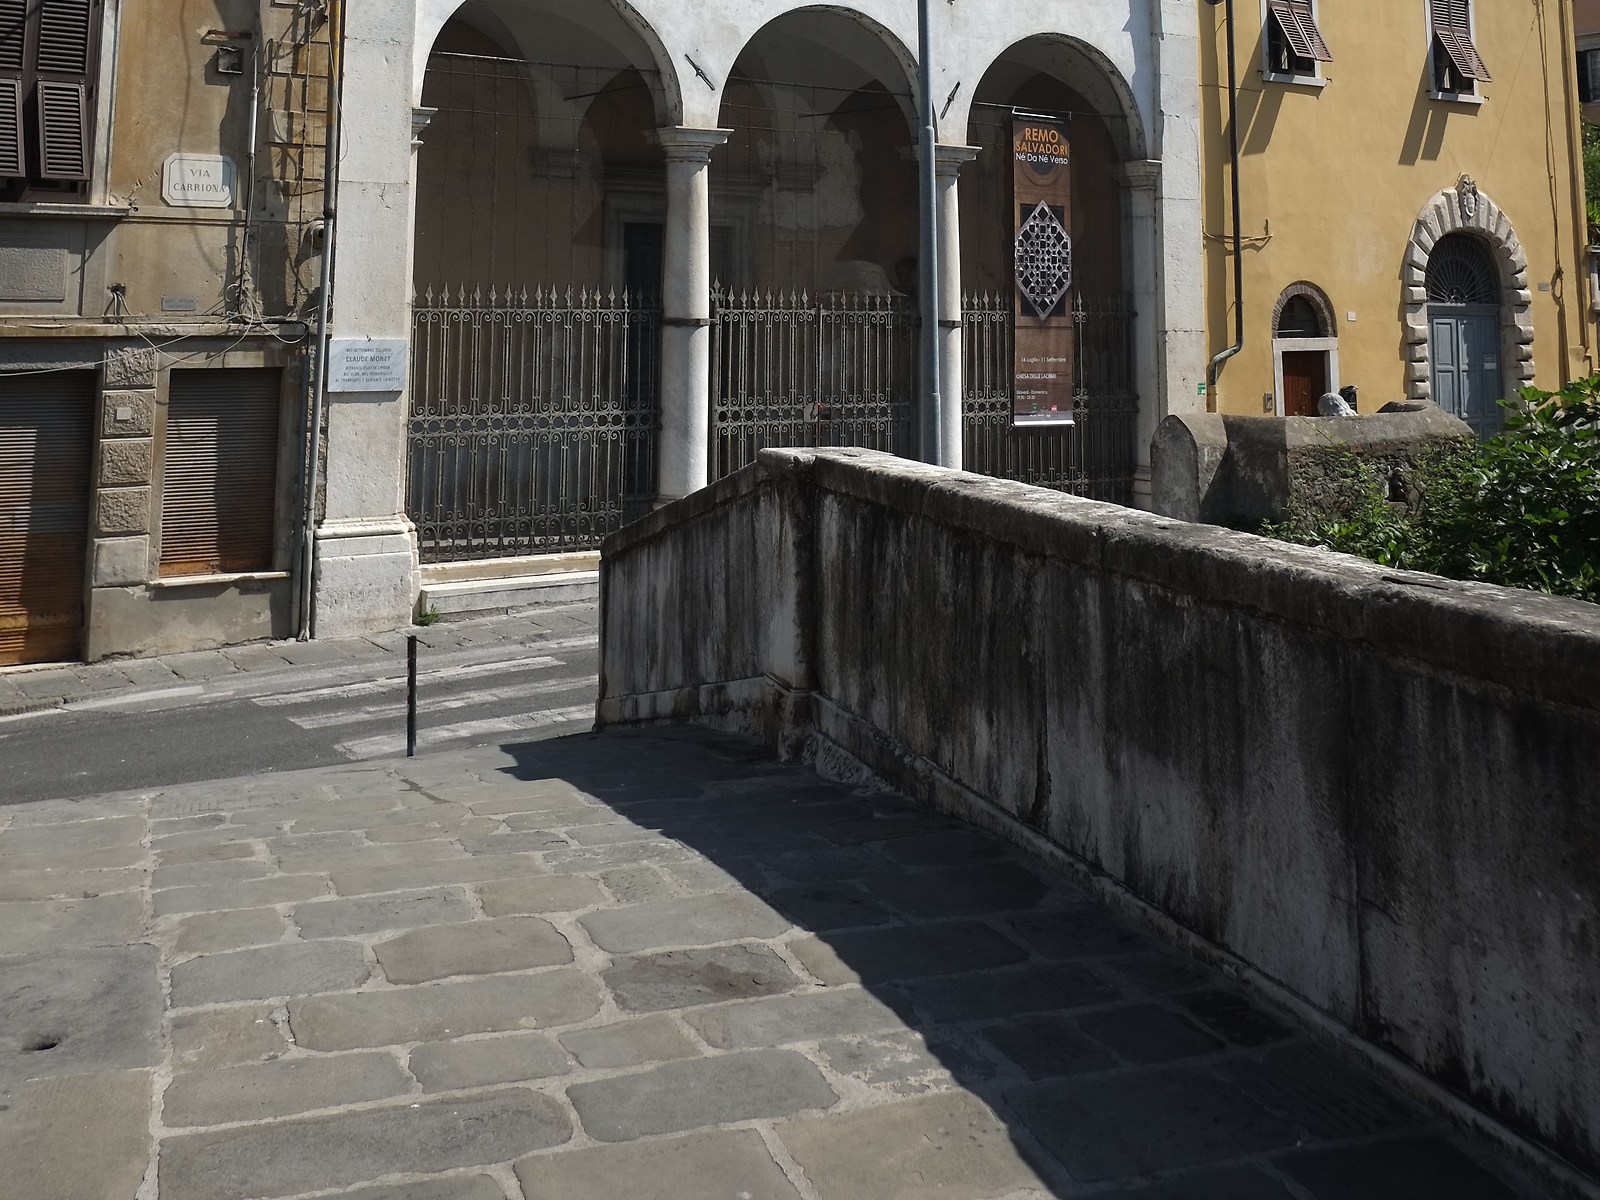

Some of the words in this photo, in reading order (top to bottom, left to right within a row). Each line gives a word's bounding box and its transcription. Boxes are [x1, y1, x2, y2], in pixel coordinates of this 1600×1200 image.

[1025, 127, 1059, 143] REMO
[1015, 141, 1068, 155] SALVADORI
[1050, 155, 1069, 164] Verso
[190, 168, 211, 178] VIA
[173, 183, 226, 193] CARRIONA
